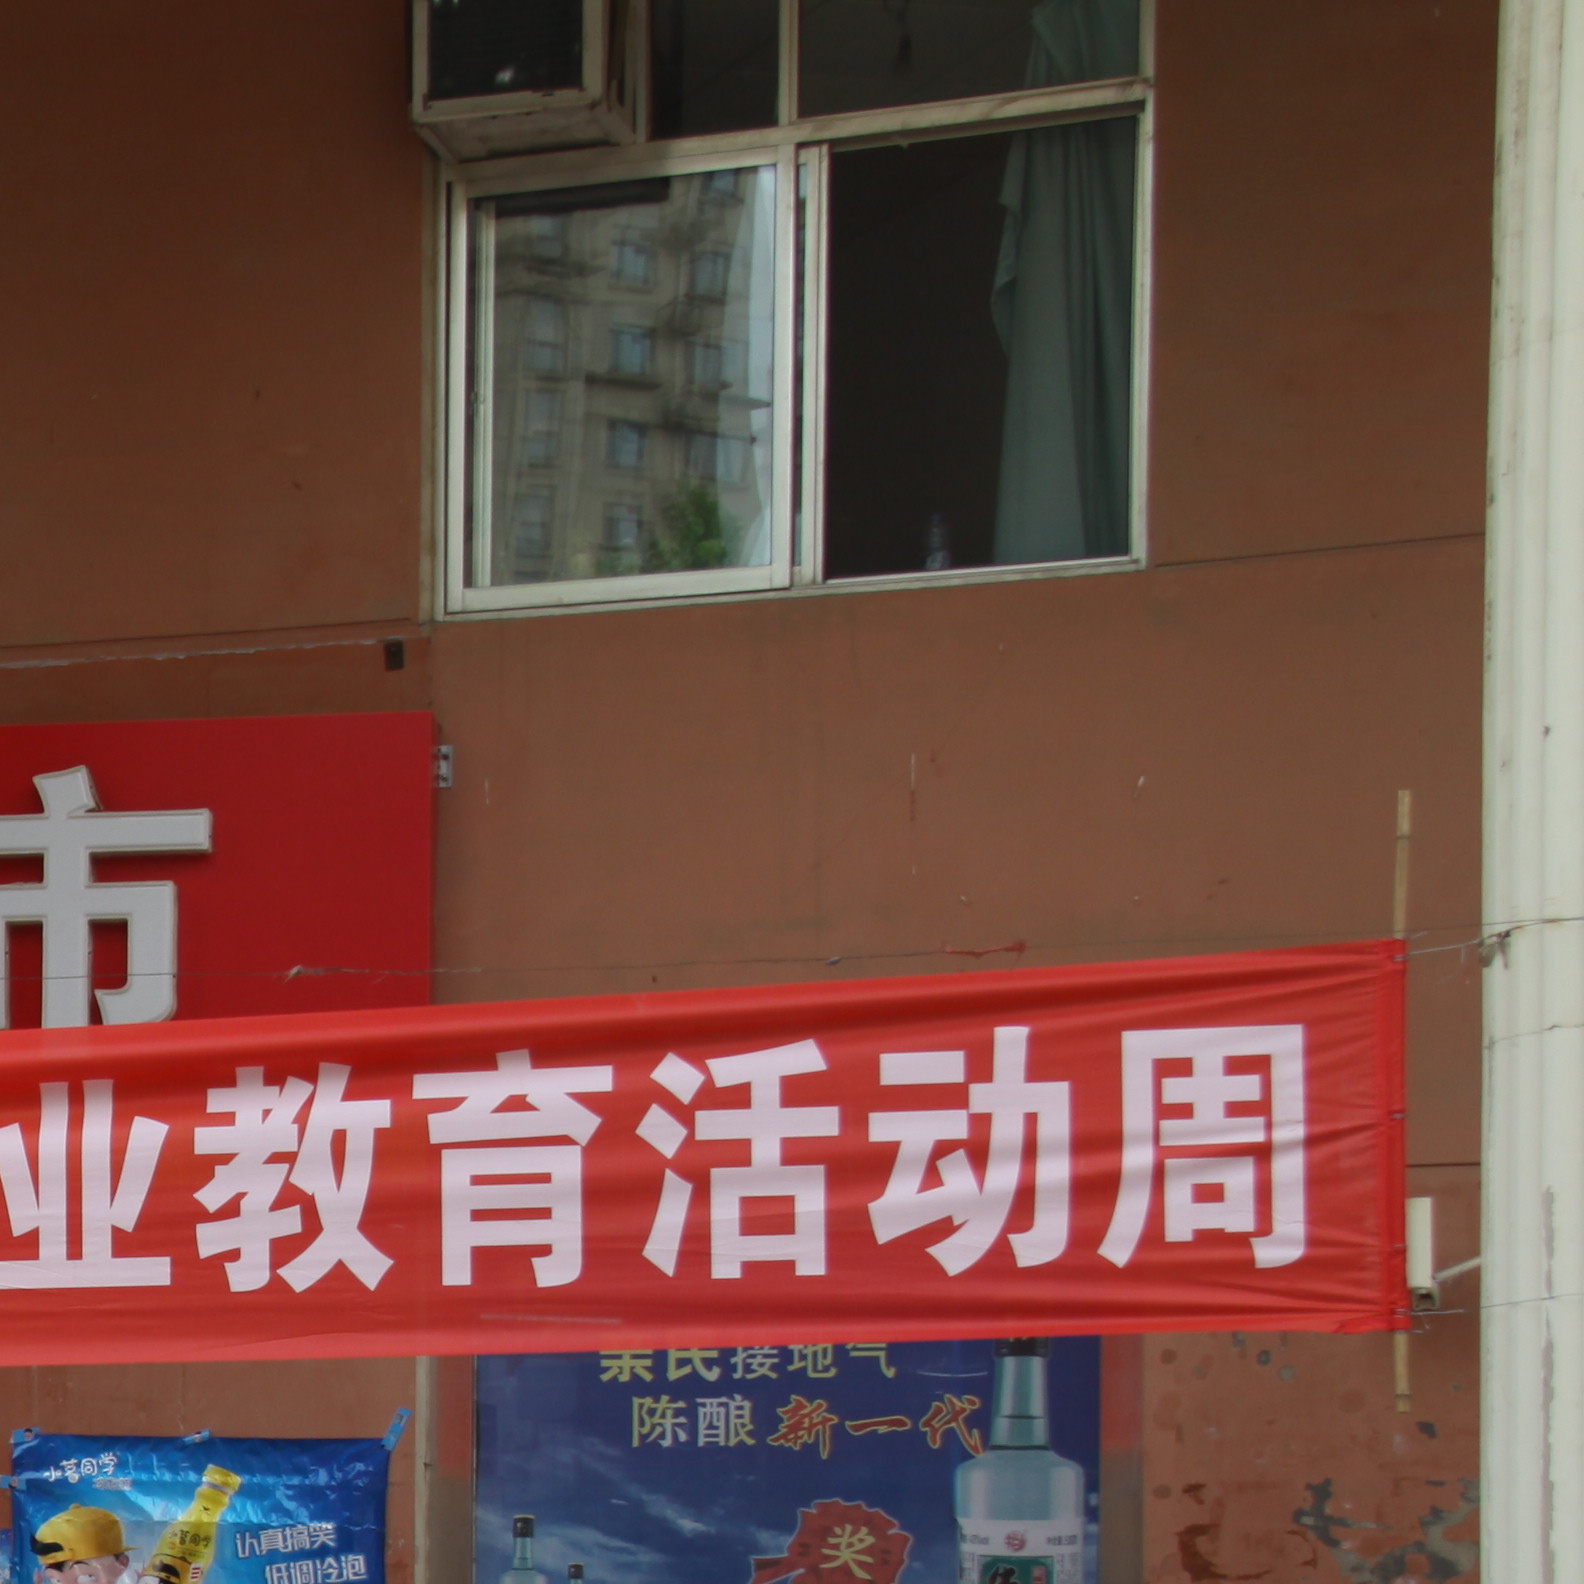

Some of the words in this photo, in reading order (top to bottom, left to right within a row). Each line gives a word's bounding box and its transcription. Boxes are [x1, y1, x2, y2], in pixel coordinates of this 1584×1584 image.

[235, 1522, 337, 1558] 认真搞笑
[820, 1524, 875, 1580] 奖
